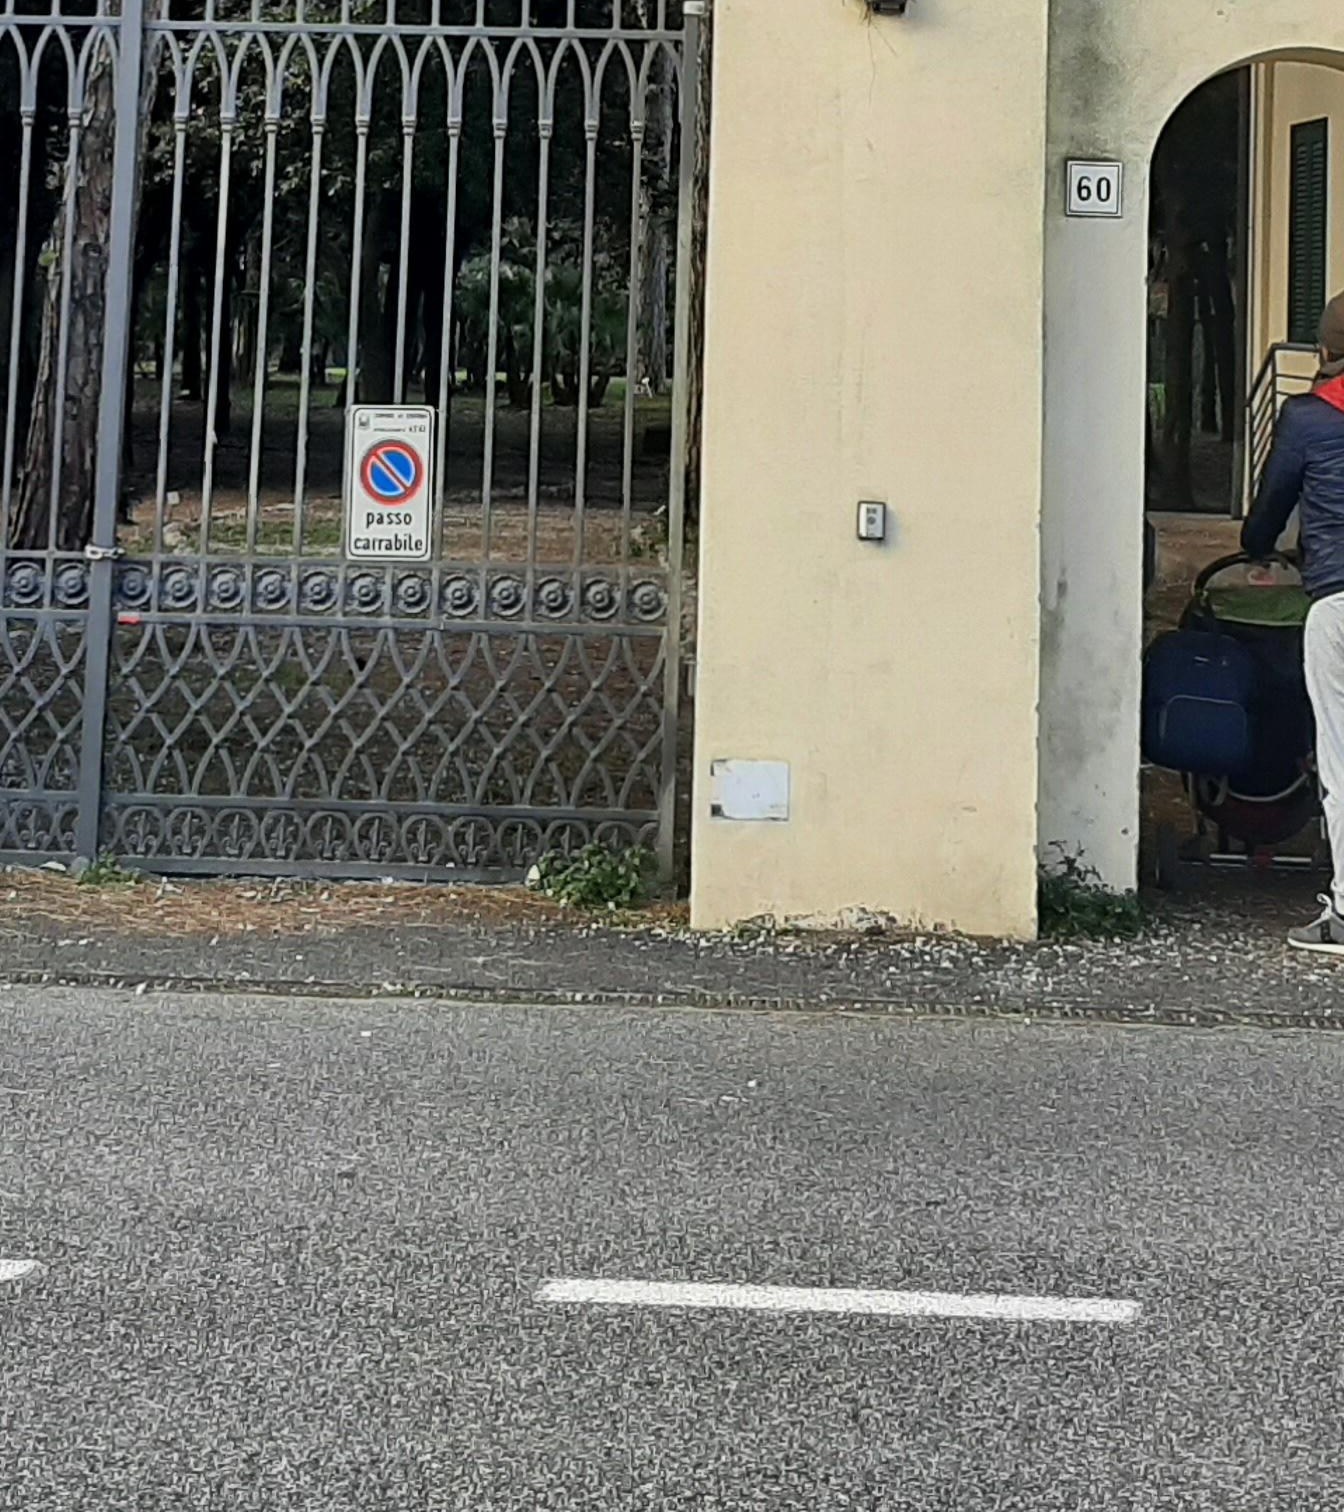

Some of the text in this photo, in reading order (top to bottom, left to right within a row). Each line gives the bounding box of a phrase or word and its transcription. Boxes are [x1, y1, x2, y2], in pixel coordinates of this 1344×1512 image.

[1076, 175, 1112, 203] 60
[366, 511, 412, 527] passo
[354, 533, 423, 551] carrabile
